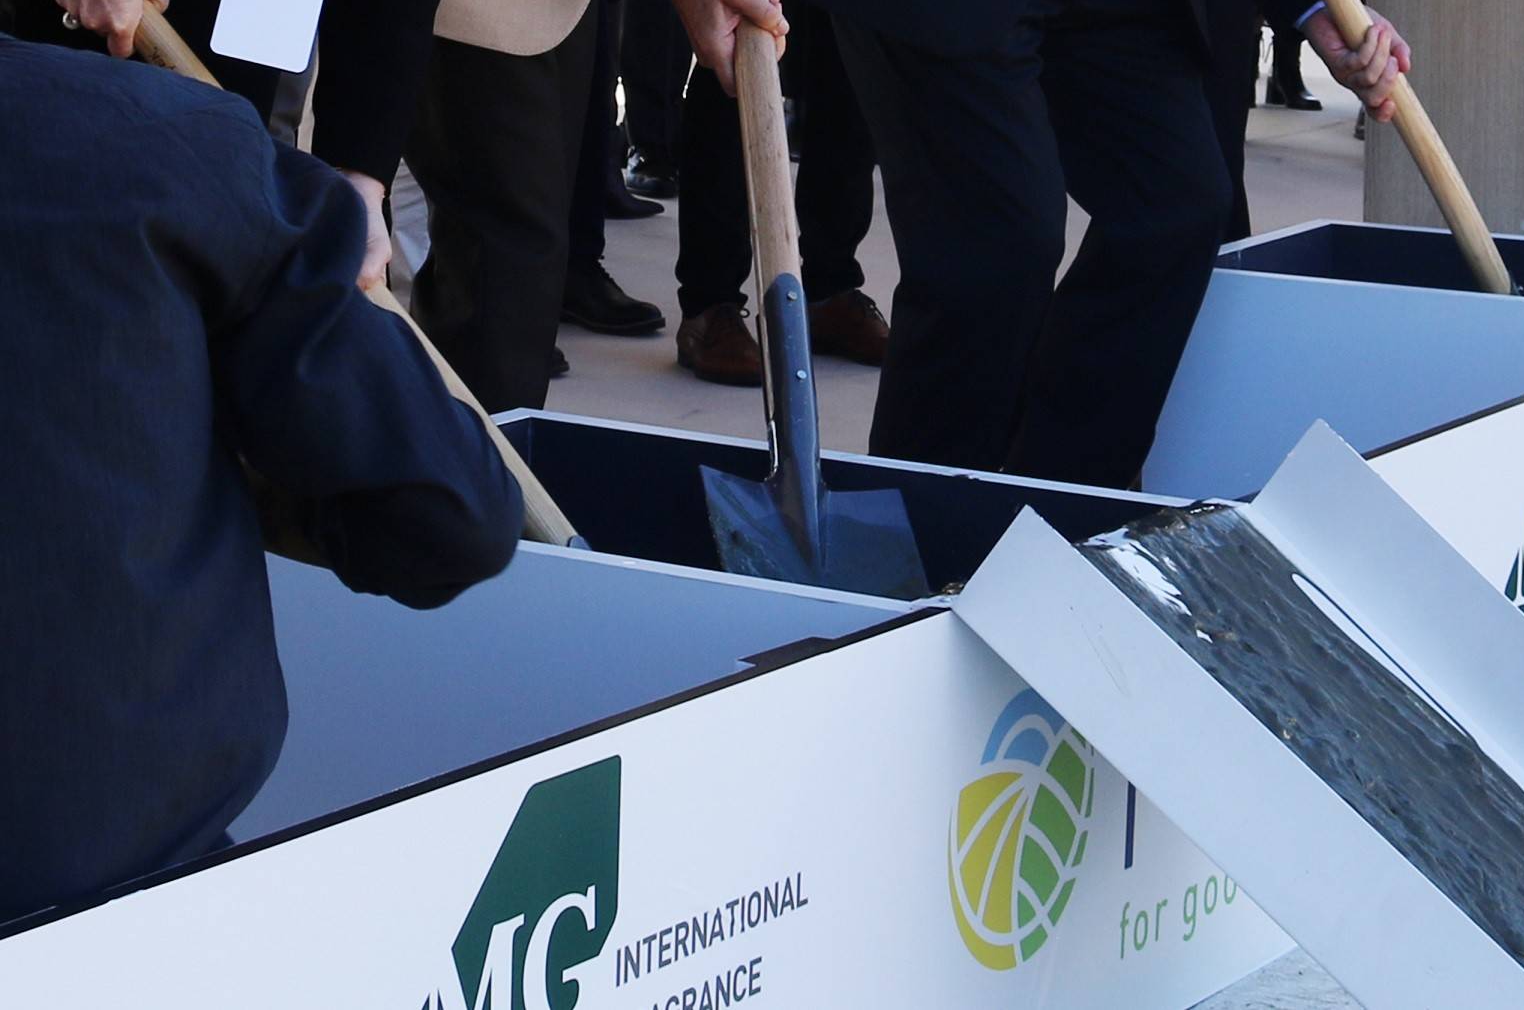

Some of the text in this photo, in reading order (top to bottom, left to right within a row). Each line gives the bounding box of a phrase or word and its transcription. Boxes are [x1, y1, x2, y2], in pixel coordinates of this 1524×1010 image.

[615, 872, 809, 988] INTERNATIONAL
[1119, 898, 1169, 961] for
[651, 956, 763, 1010] RANCE
